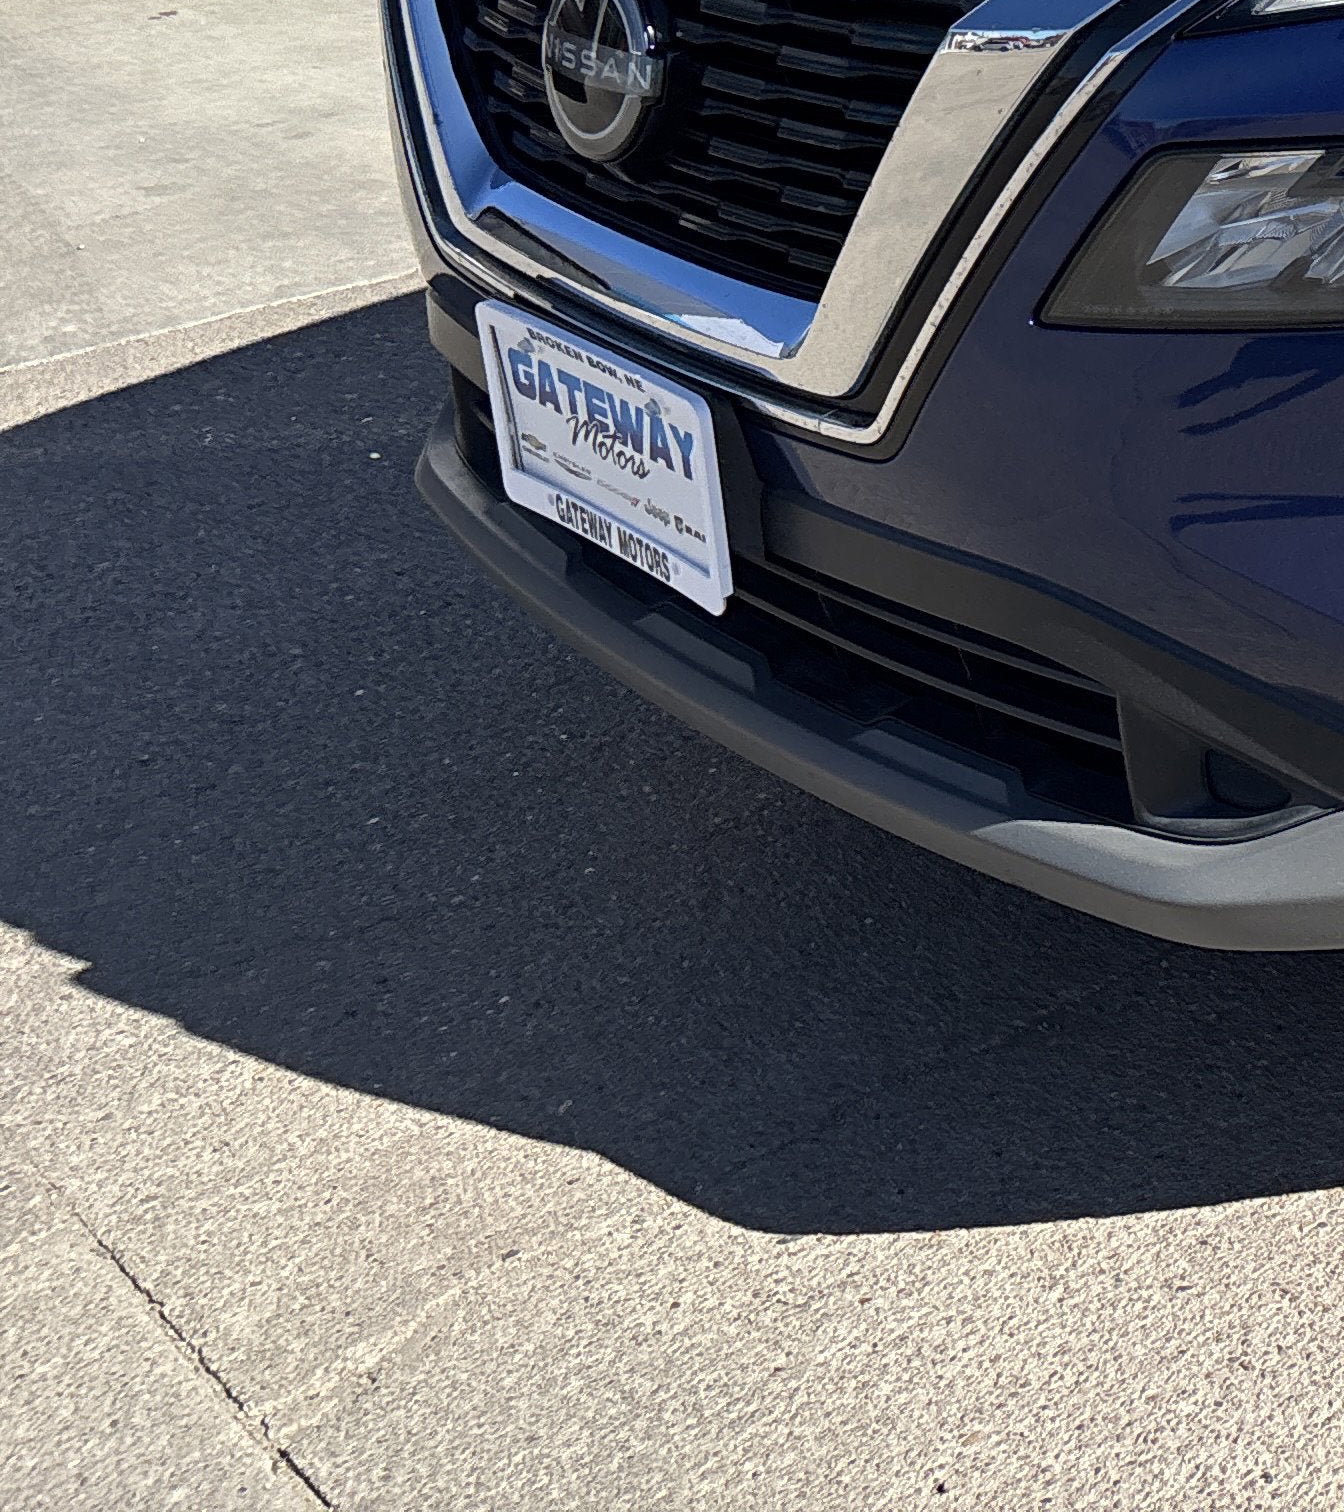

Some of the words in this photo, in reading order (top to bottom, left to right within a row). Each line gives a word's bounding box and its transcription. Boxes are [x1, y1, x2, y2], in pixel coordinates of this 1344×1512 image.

[546, 33, 652, 89] NISSAN
[526, 327, 585, 363] BROKEN
[585, 354, 623, 384] BOW,
[623, 373, 646, 393] NE
[508, 347, 694, 481] GATEWAY
[566, 416, 650, 480] Motors
[556, 493, 614, 549] GATEWAY
[617, 525, 671, 583] MOTORS
